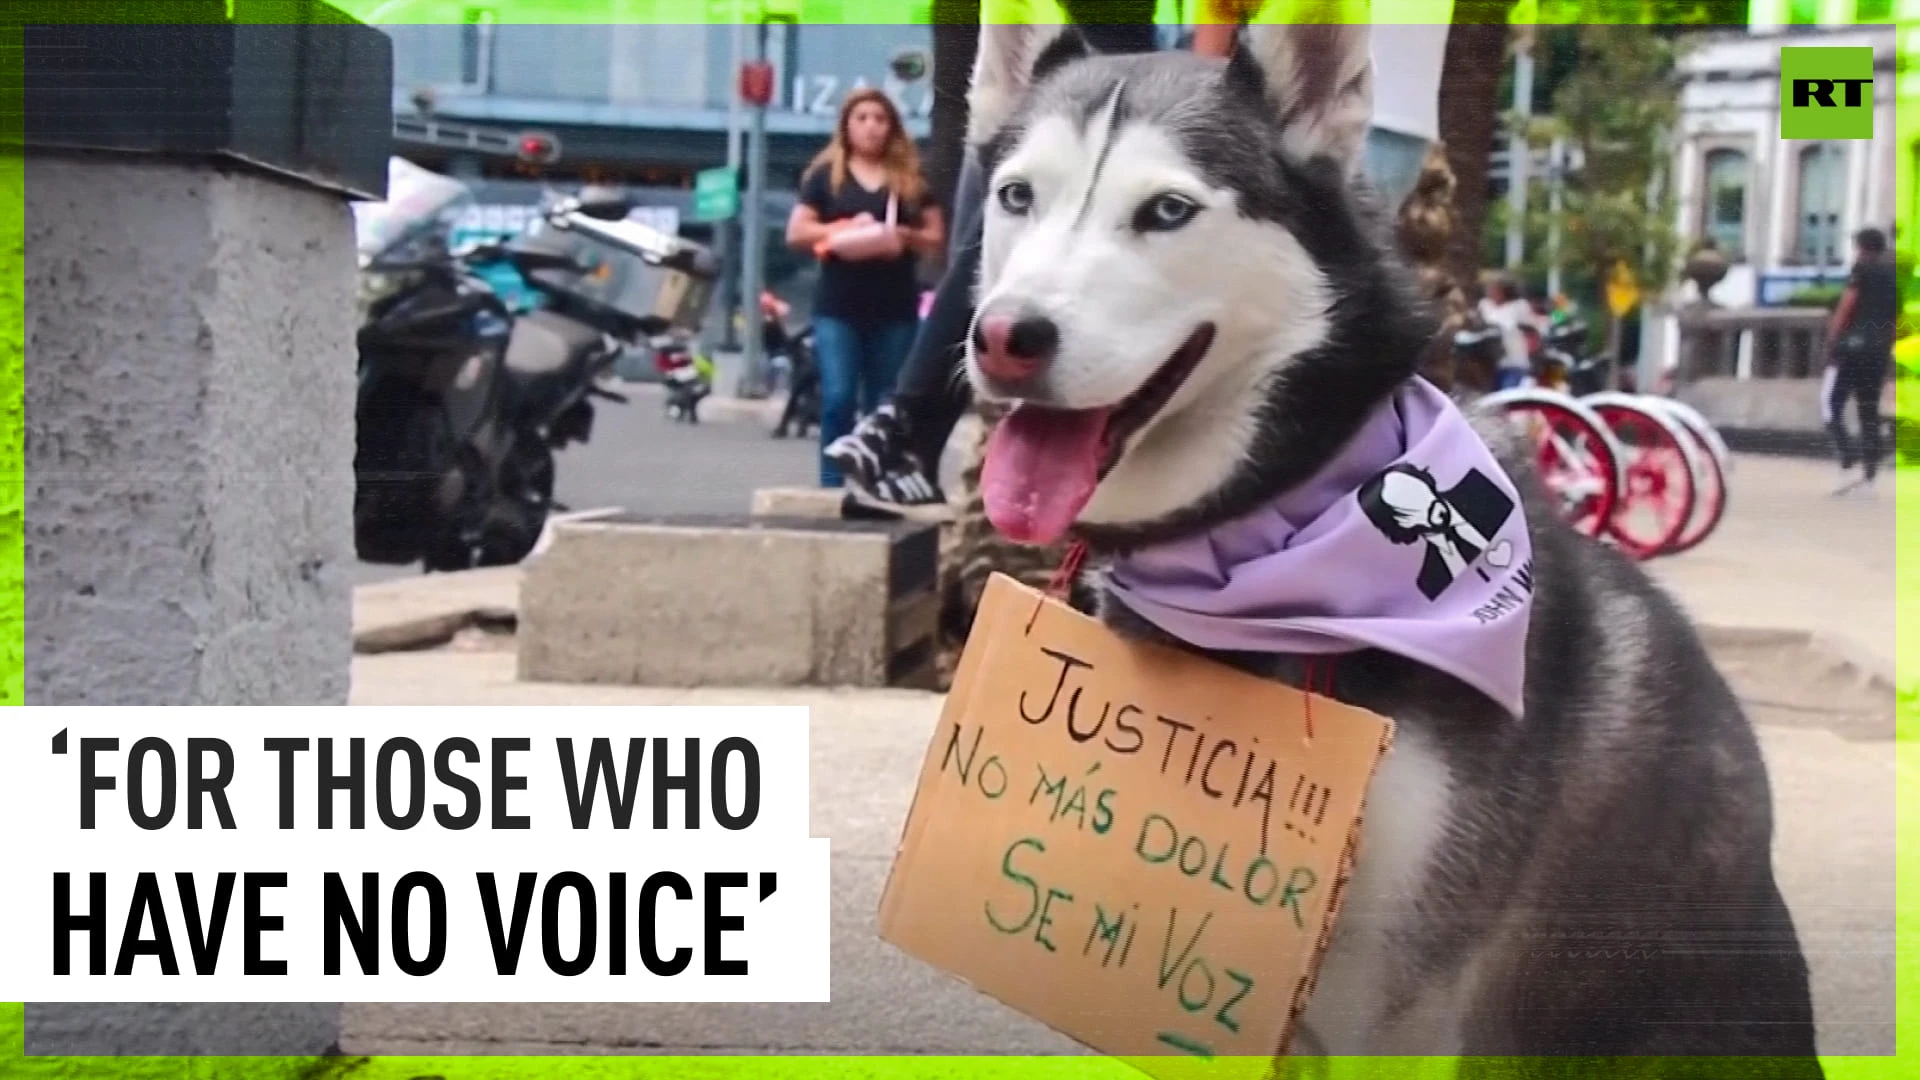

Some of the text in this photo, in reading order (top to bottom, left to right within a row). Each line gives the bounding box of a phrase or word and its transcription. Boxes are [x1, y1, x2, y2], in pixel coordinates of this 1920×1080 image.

[1473, 586, 1524, 624] JOHN
[1476, 567, 1491, 583] I
[940, 723, 1319, 928] NO MÁS DOLOR
[983, 837, 1074, 953] SE
[1157, 907, 1255, 1033] VOZ
